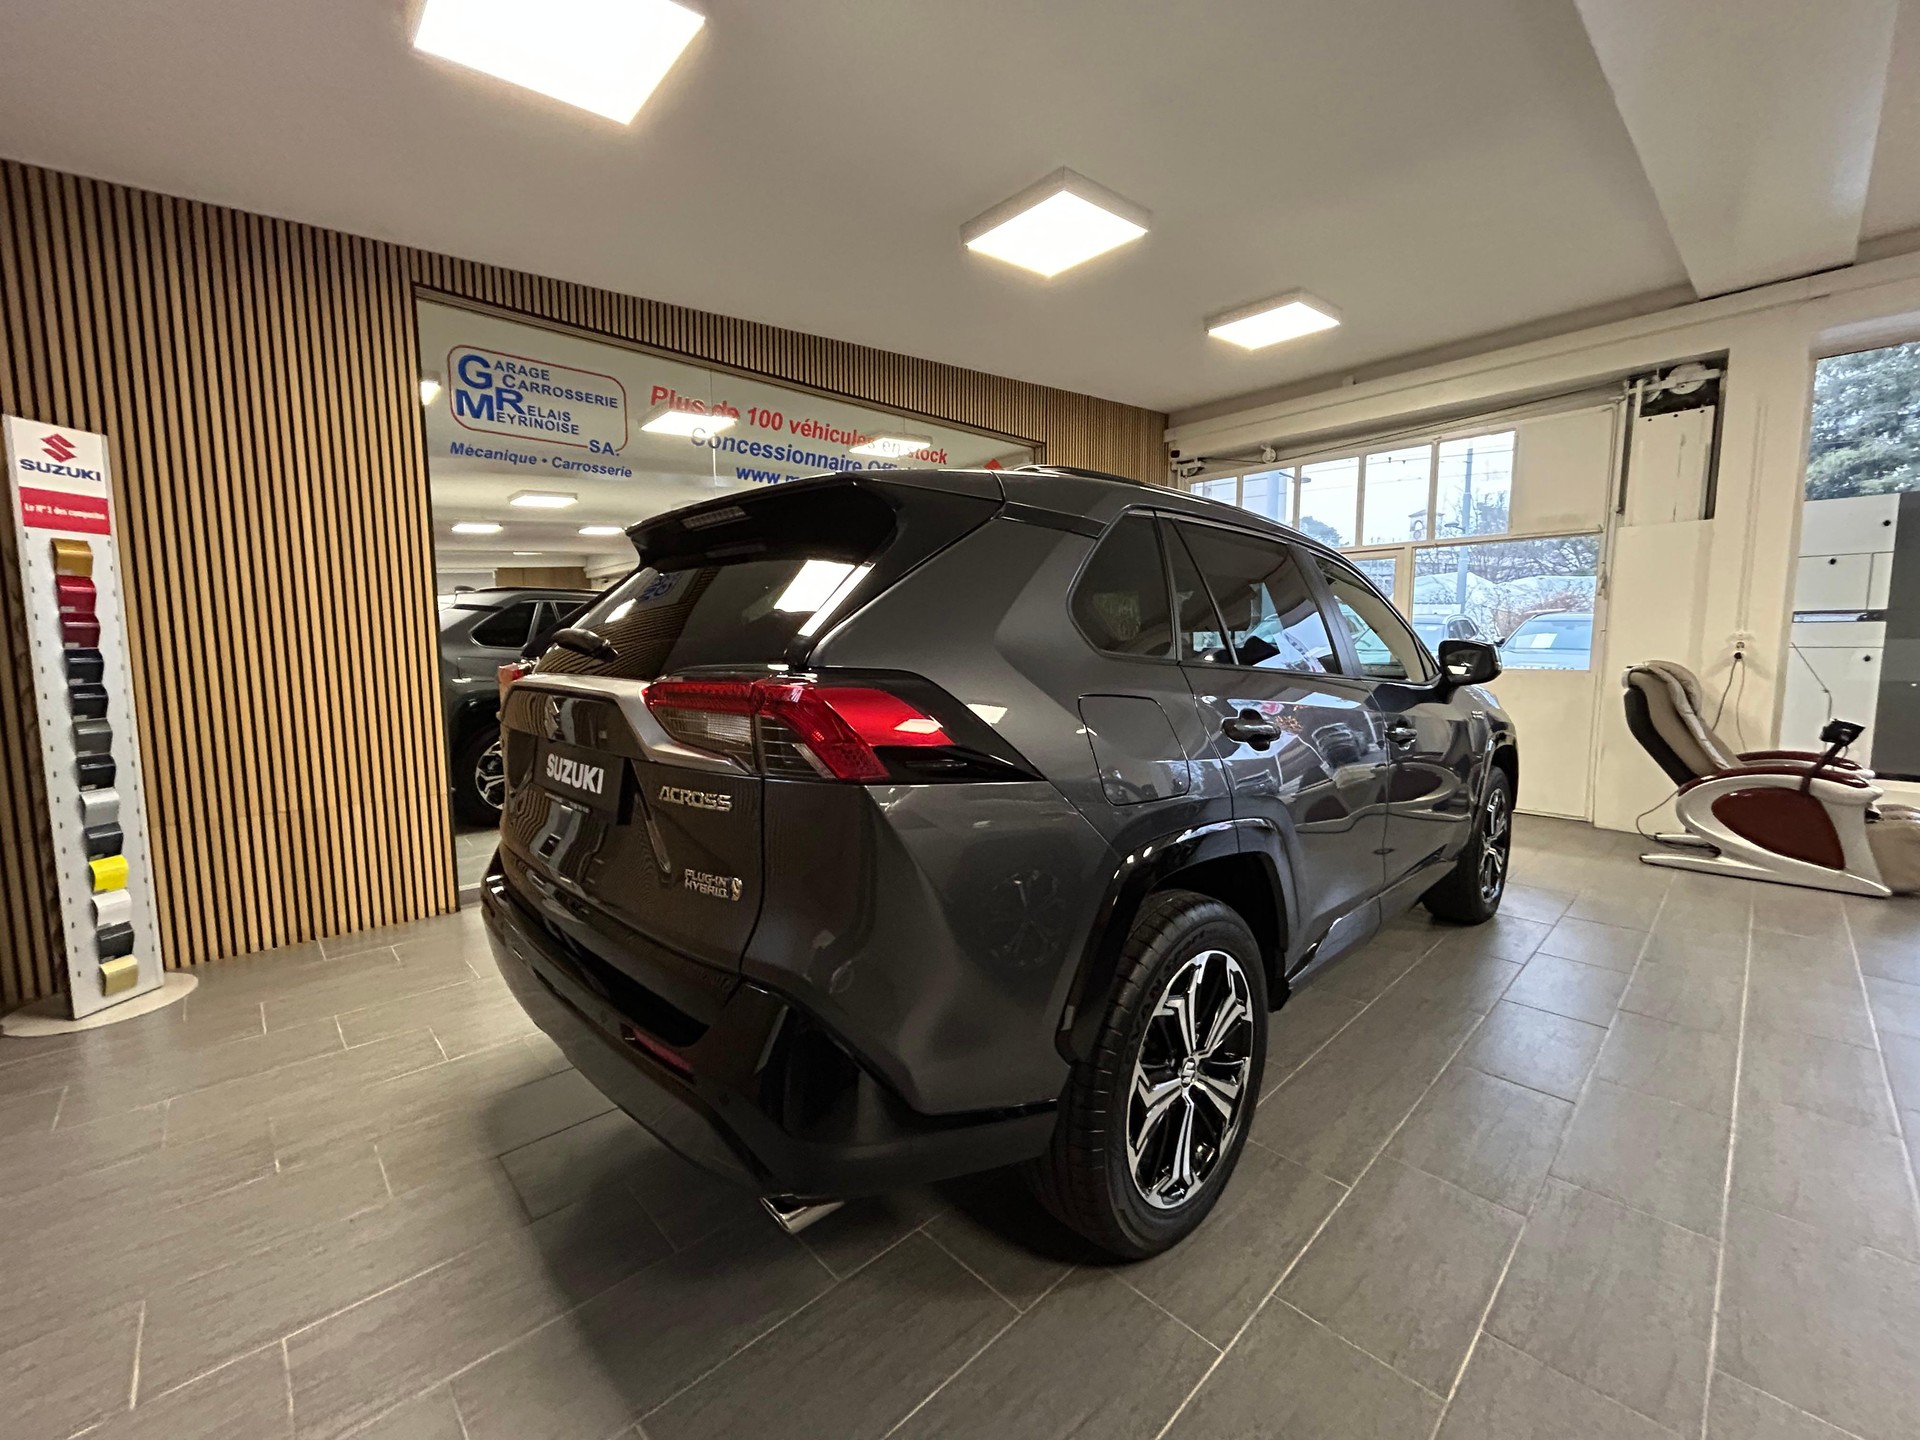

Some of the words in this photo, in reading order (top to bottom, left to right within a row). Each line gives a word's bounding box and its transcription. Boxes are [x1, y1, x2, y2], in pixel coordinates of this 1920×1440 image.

[458, 354, 550, 390] GARAGE
[495, 386, 571, 423] RELAIS
[502, 374, 619, 409] CARROSSERIE
[455, 388, 580, 435] MEYRINOISE
[650, 385, 706, 413] Plus
[711, 400, 740, 420] de
[747, 406, 784, 431] 100
[789, 418, 876, 449] véhicules
[882, 441, 901, 455] en
[906, 445, 948, 465] stock
[450, 441, 537, 466] Mécanique
[552, 456, 633, 478] Carrosserie
[691, 427, 863, 470] Concessionnaire
[20, 458, 102, 482] SUZUKI
[546, 753, 604, 795] SUZUKI
[658, 785, 733, 812] ACROSS
[685, 868, 728, 888] PLUG-IN
[685, 879, 729, 899] HYBRID
